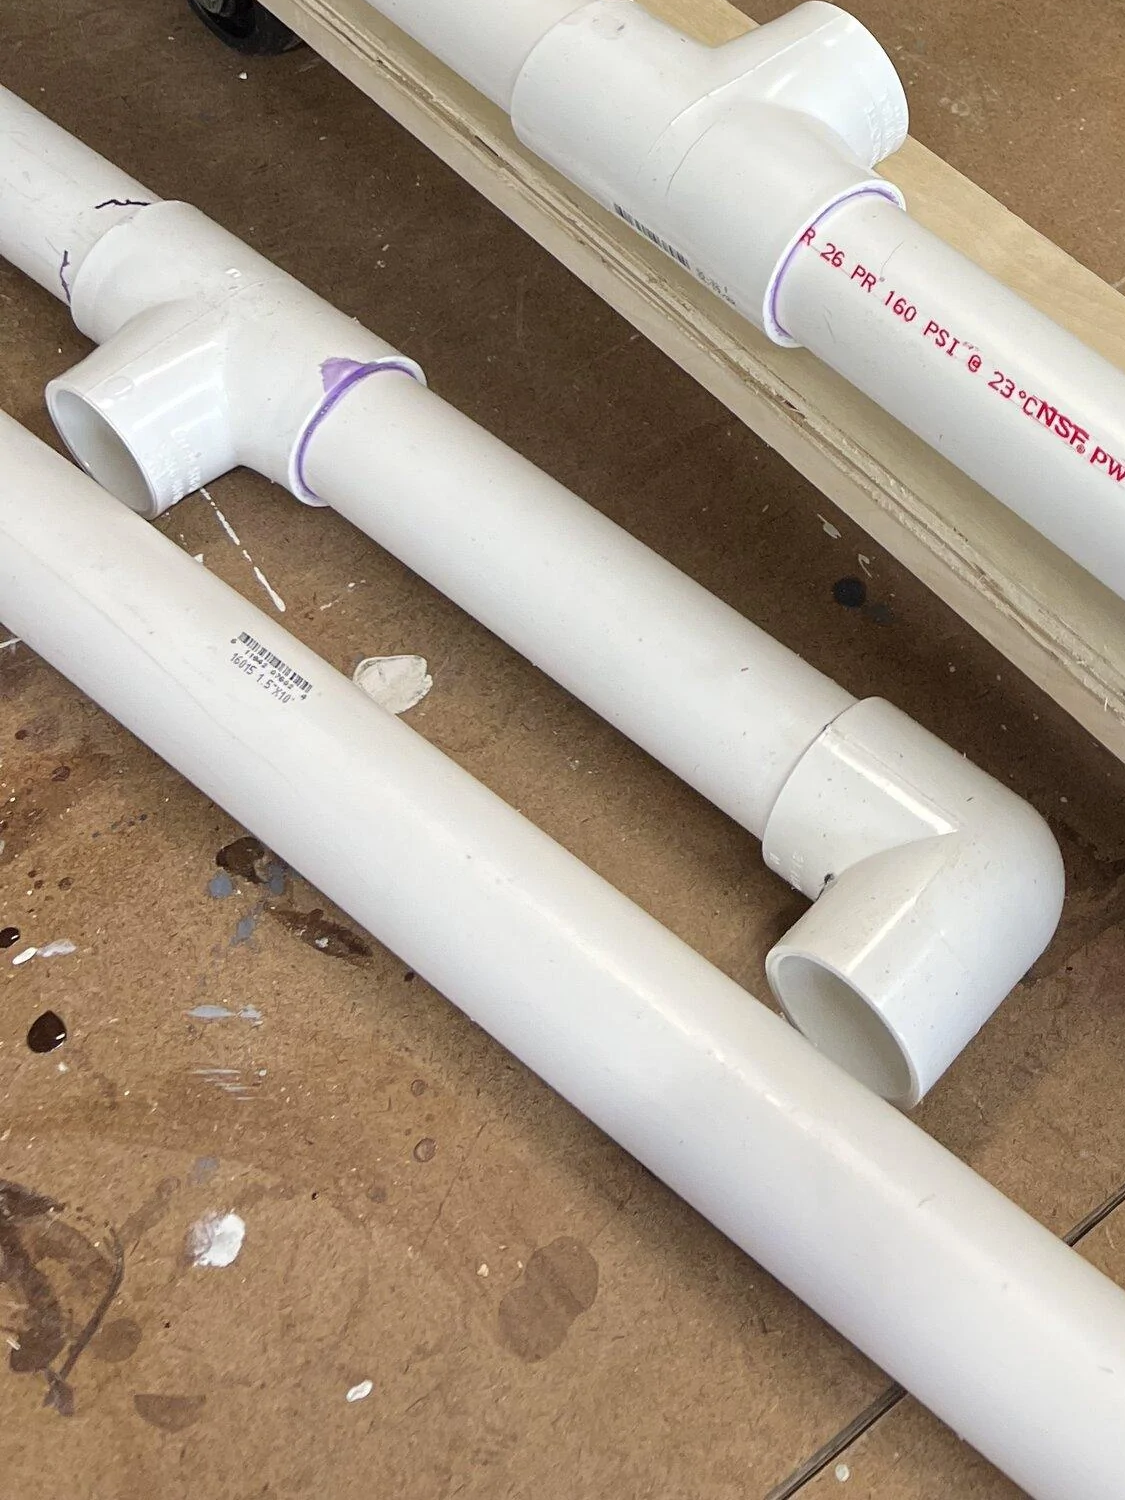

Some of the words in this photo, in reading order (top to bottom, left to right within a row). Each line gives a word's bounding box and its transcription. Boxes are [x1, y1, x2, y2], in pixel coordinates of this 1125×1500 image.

[820, 242, 846, 268] 26
[850, 264, 877, 293] PR
[884, 290, 918, 323] 160
[923, 320, 961, 356] PSI
[967, 354, 983, 373] @
[230, 652, 257, 675] 16015
